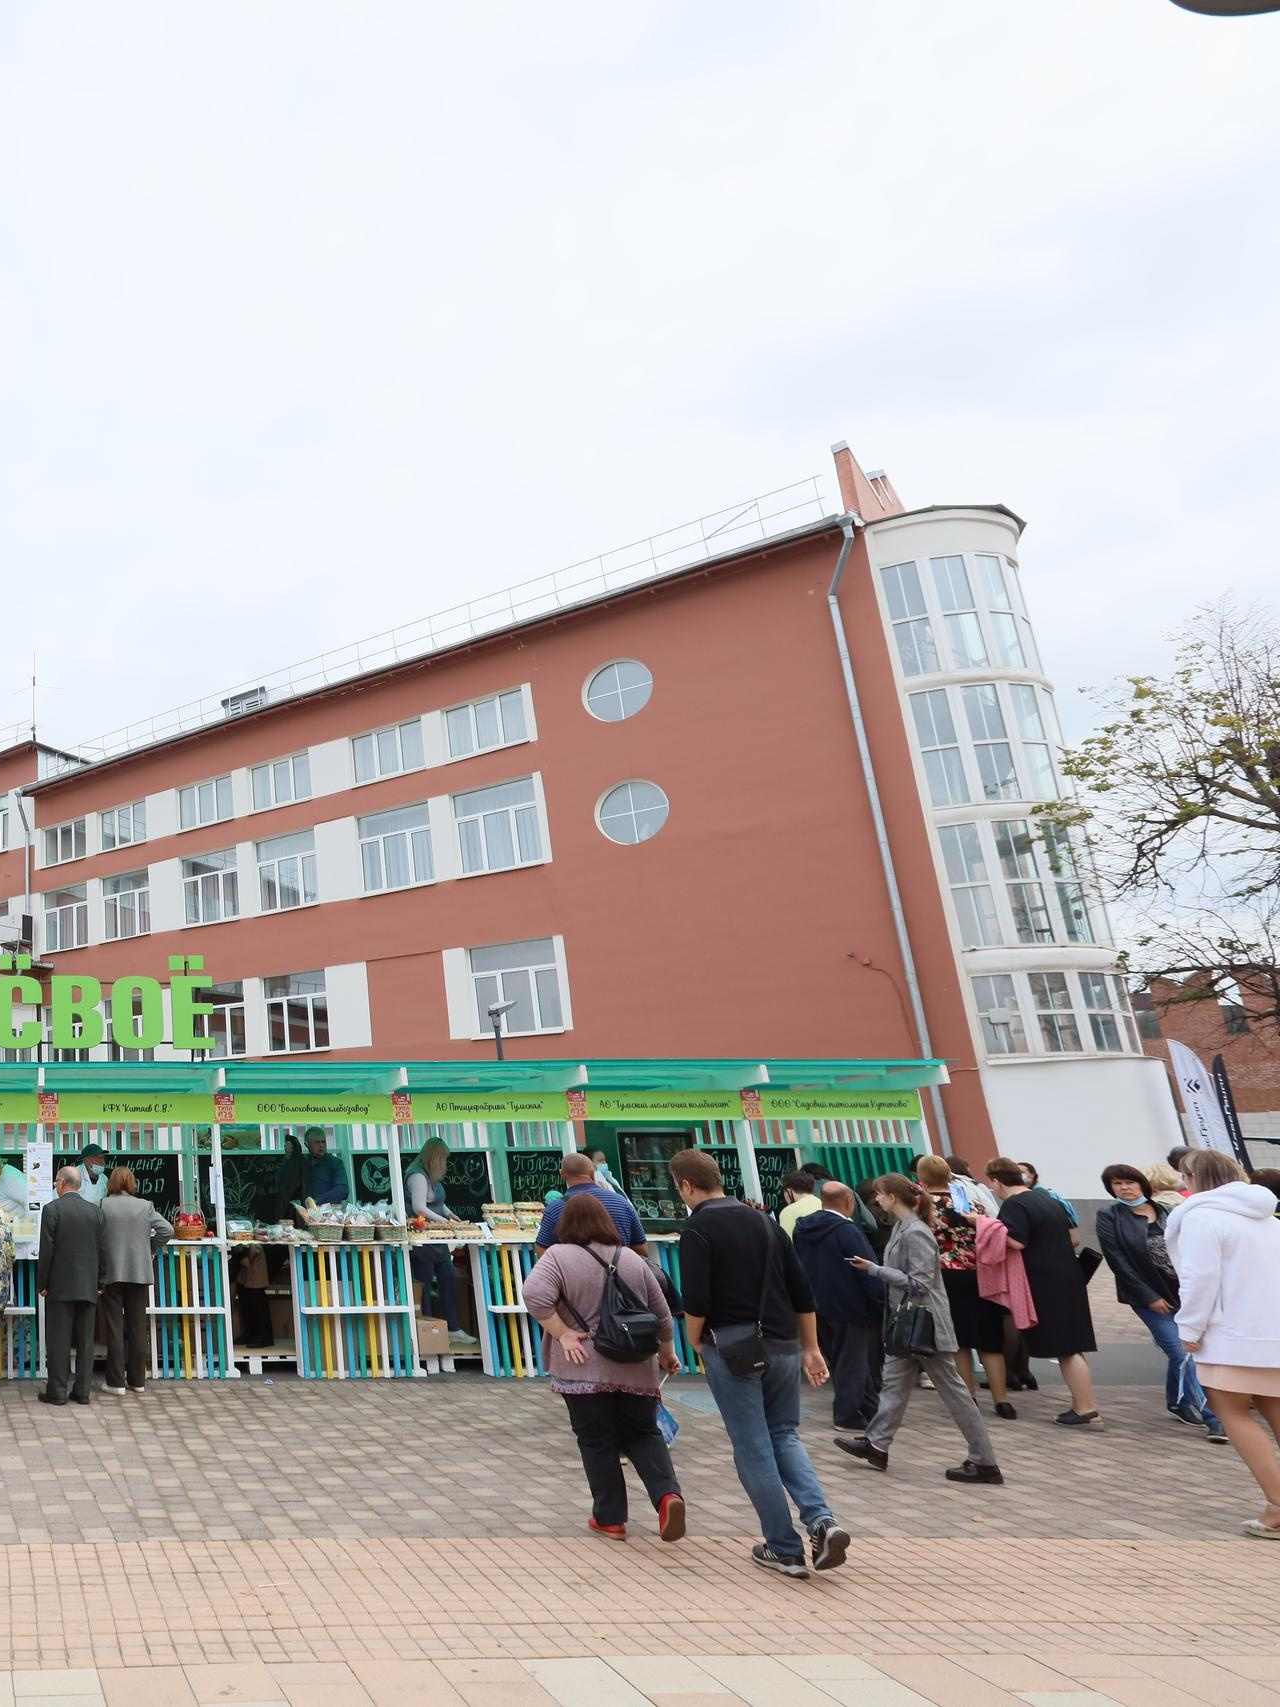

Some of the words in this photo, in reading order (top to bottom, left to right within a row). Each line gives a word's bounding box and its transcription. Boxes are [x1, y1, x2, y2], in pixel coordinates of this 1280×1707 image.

[102, 1103, 120, 1113] КФХ
[257, 1103, 277, 1113] ООО
[436, 1102, 447, 1112] АО
[600, 1099, 611, 1109] АО
[771, 1100, 791, 1108] ООО
